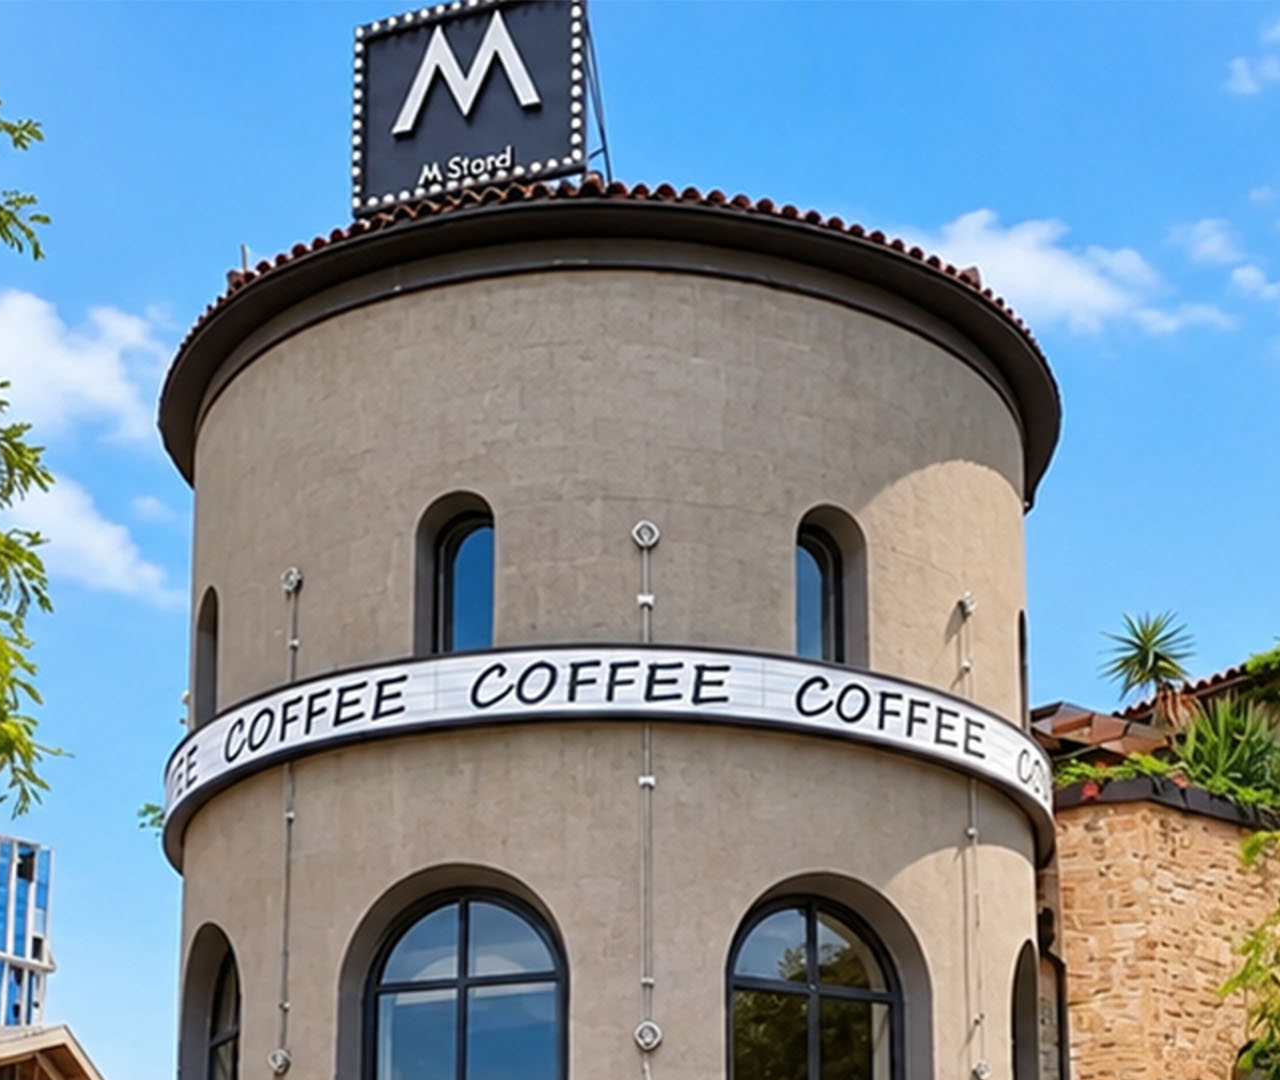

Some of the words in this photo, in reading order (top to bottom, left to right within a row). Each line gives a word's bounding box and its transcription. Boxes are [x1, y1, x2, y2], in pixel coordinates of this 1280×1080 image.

[392, 9, 541, 135] M
[418, 162, 442, 185] M
[224, 674, 408, 763] COFFEE
[470, 659, 731, 709] COFFEE
[795, 675, 986, 759] COFFEE
